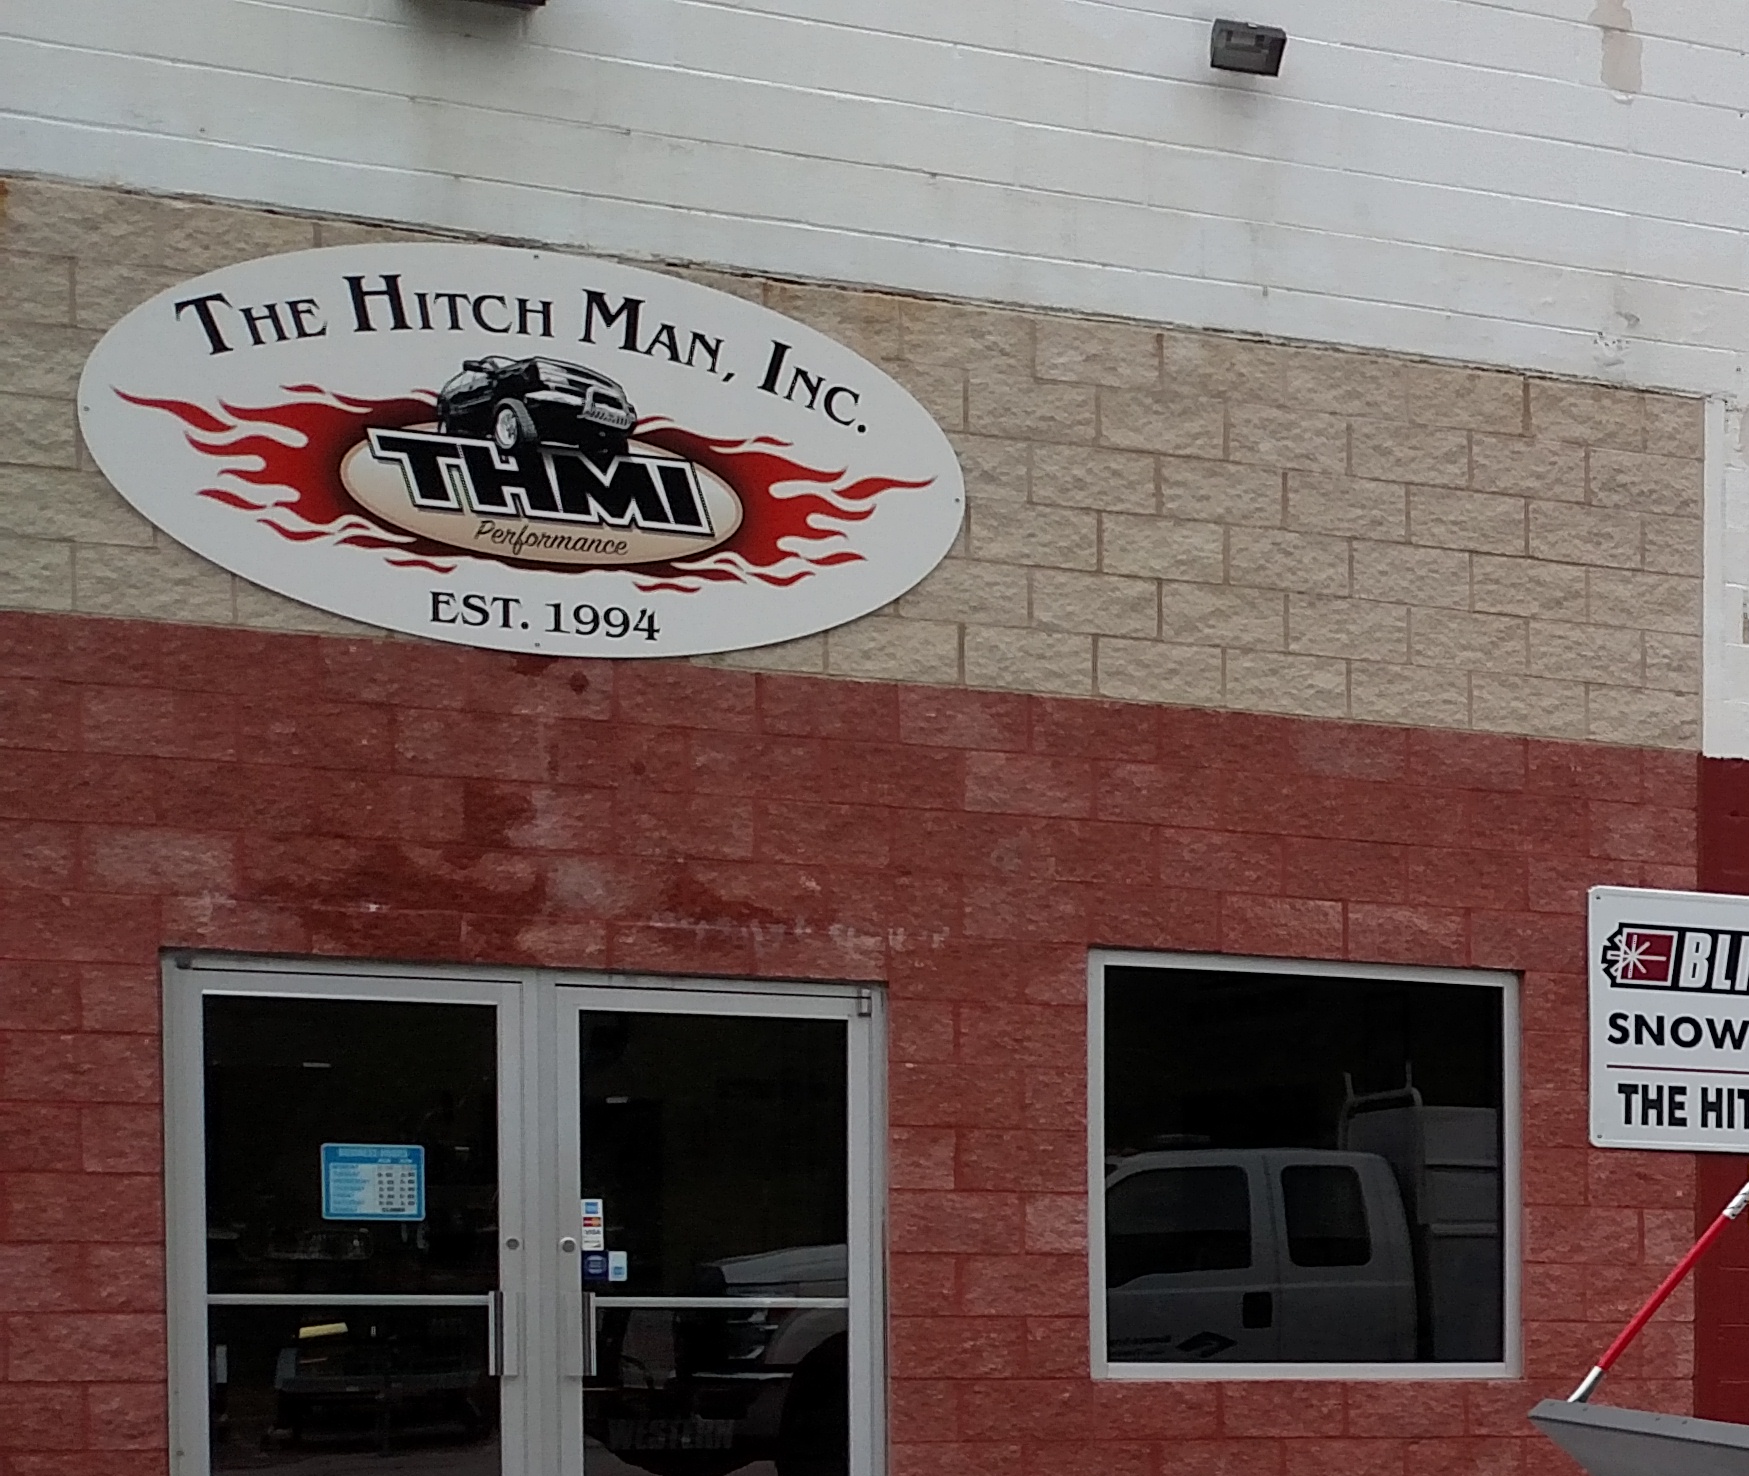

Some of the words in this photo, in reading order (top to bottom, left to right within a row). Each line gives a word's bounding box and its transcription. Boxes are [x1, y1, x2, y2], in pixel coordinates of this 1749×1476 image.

[174, 293, 327, 356] THE
[343, 275, 555, 338] HITCH
[581, 288, 735, 384] MAN,
[761, 338, 869, 434] INC.
[366, 428, 716, 538] THMI
[474, 518, 629, 558] Performance
[429, 591, 530, 634] EST.
[544, 602, 661, 643] 1994
[1618, 1083, 1688, 1128] THE
